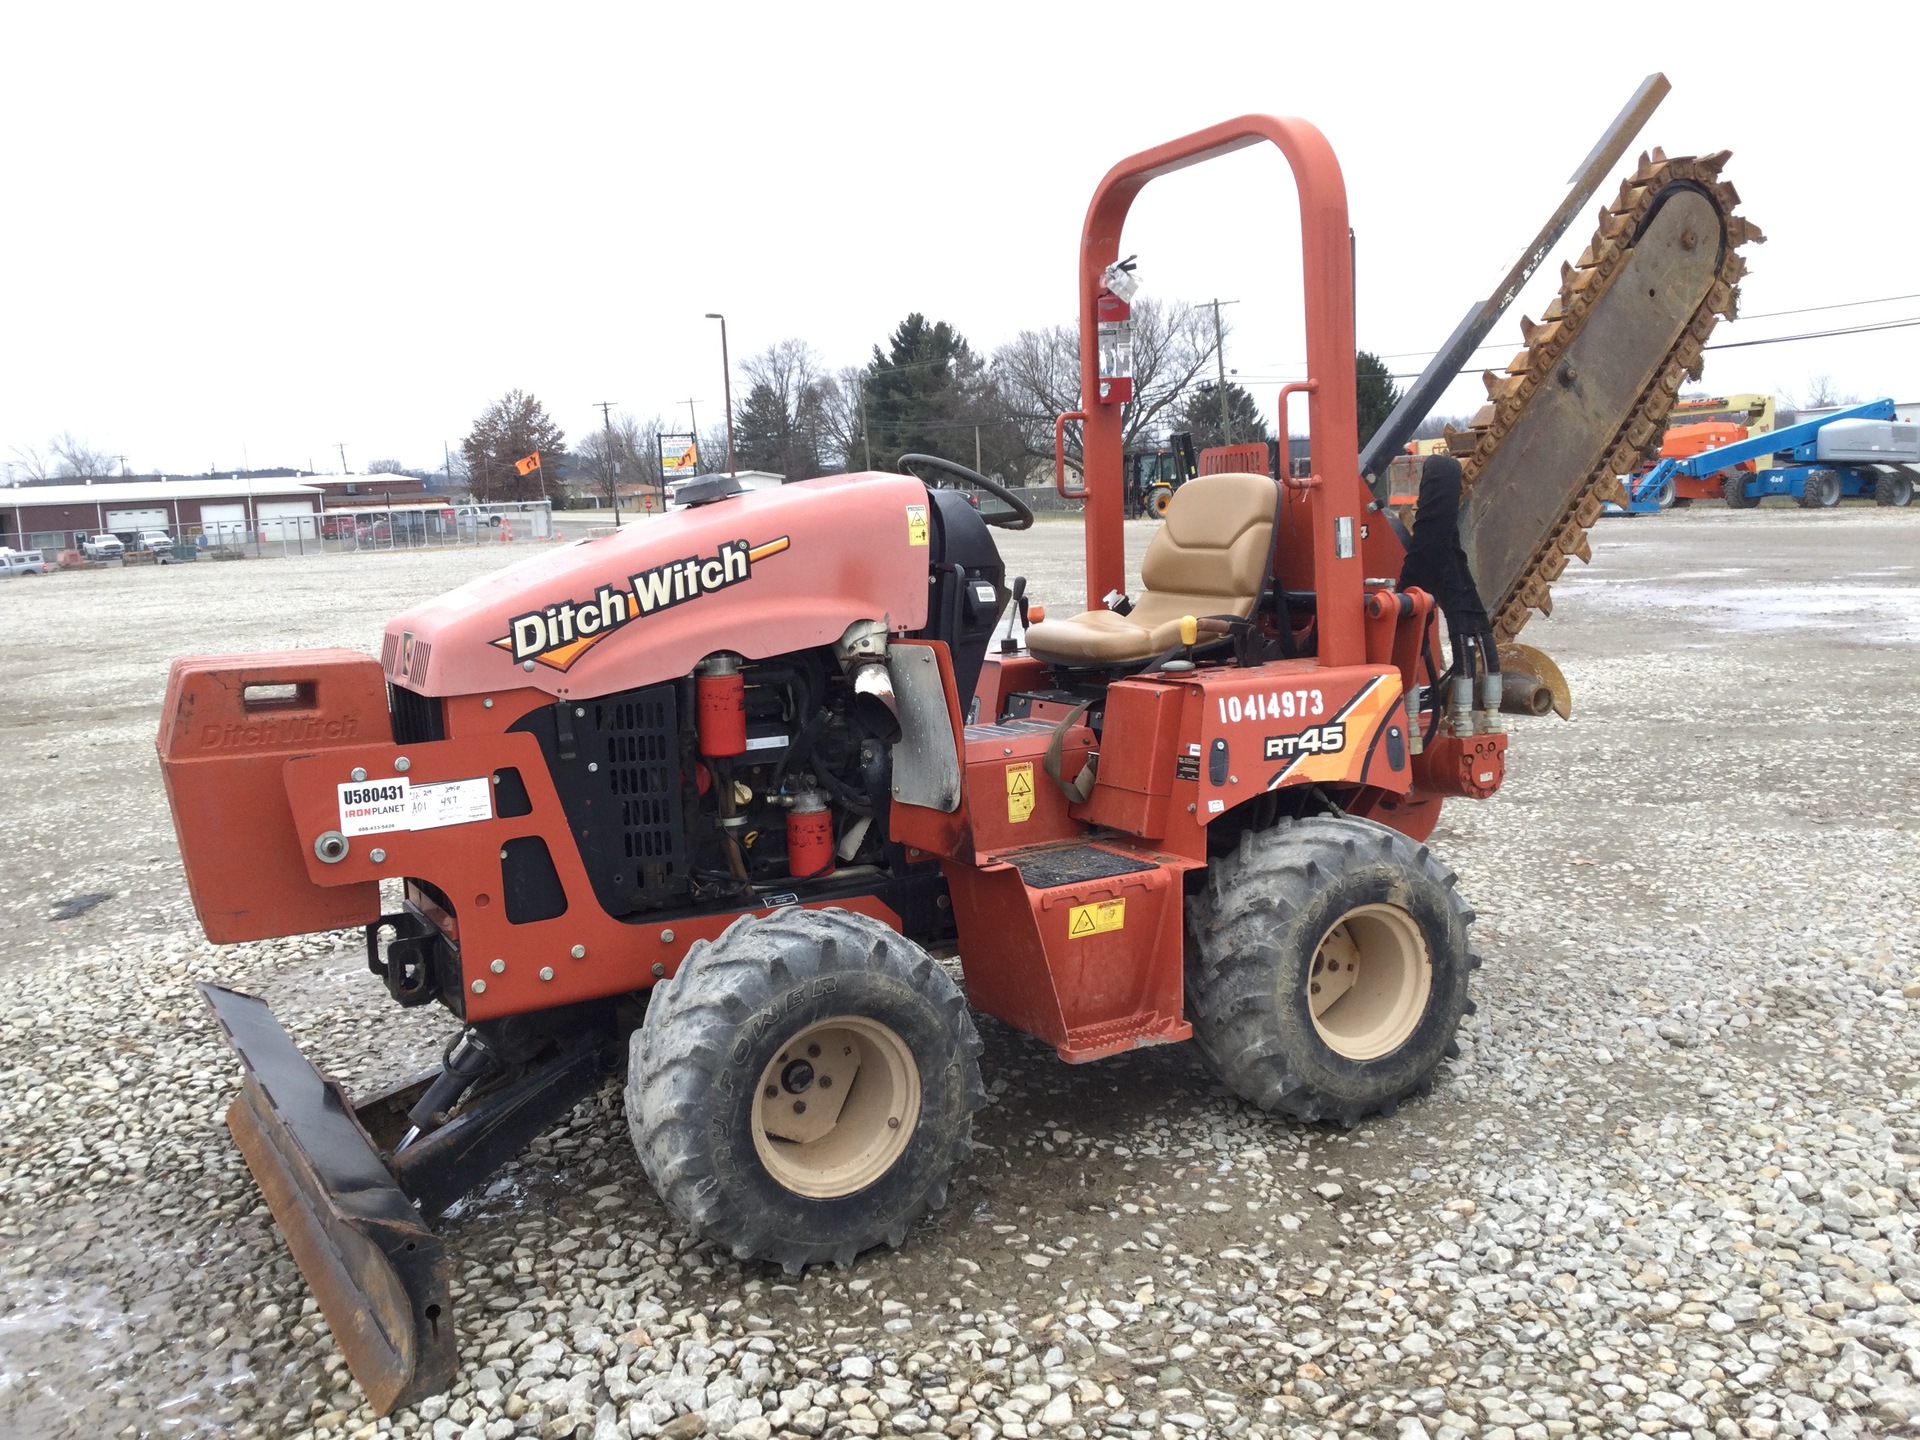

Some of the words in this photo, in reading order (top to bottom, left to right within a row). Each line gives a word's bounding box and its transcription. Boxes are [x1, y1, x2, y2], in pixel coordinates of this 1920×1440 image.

[1770, 475, 1783, 483] 4x4
[514, 588, 627, 658] Ditch
[633, 545, 748, 613] Witch
[1218, 689, 1324, 724] 10414973
[200, 720, 276, 749] Ditch
[281, 714, 359, 744] Witch
[1266, 725, 1344, 757] RT45
[344, 785, 404, 805] U580431
[345, 804, 405, 818] IRONPLANET
[717, 975, 839, 1098] POWER
